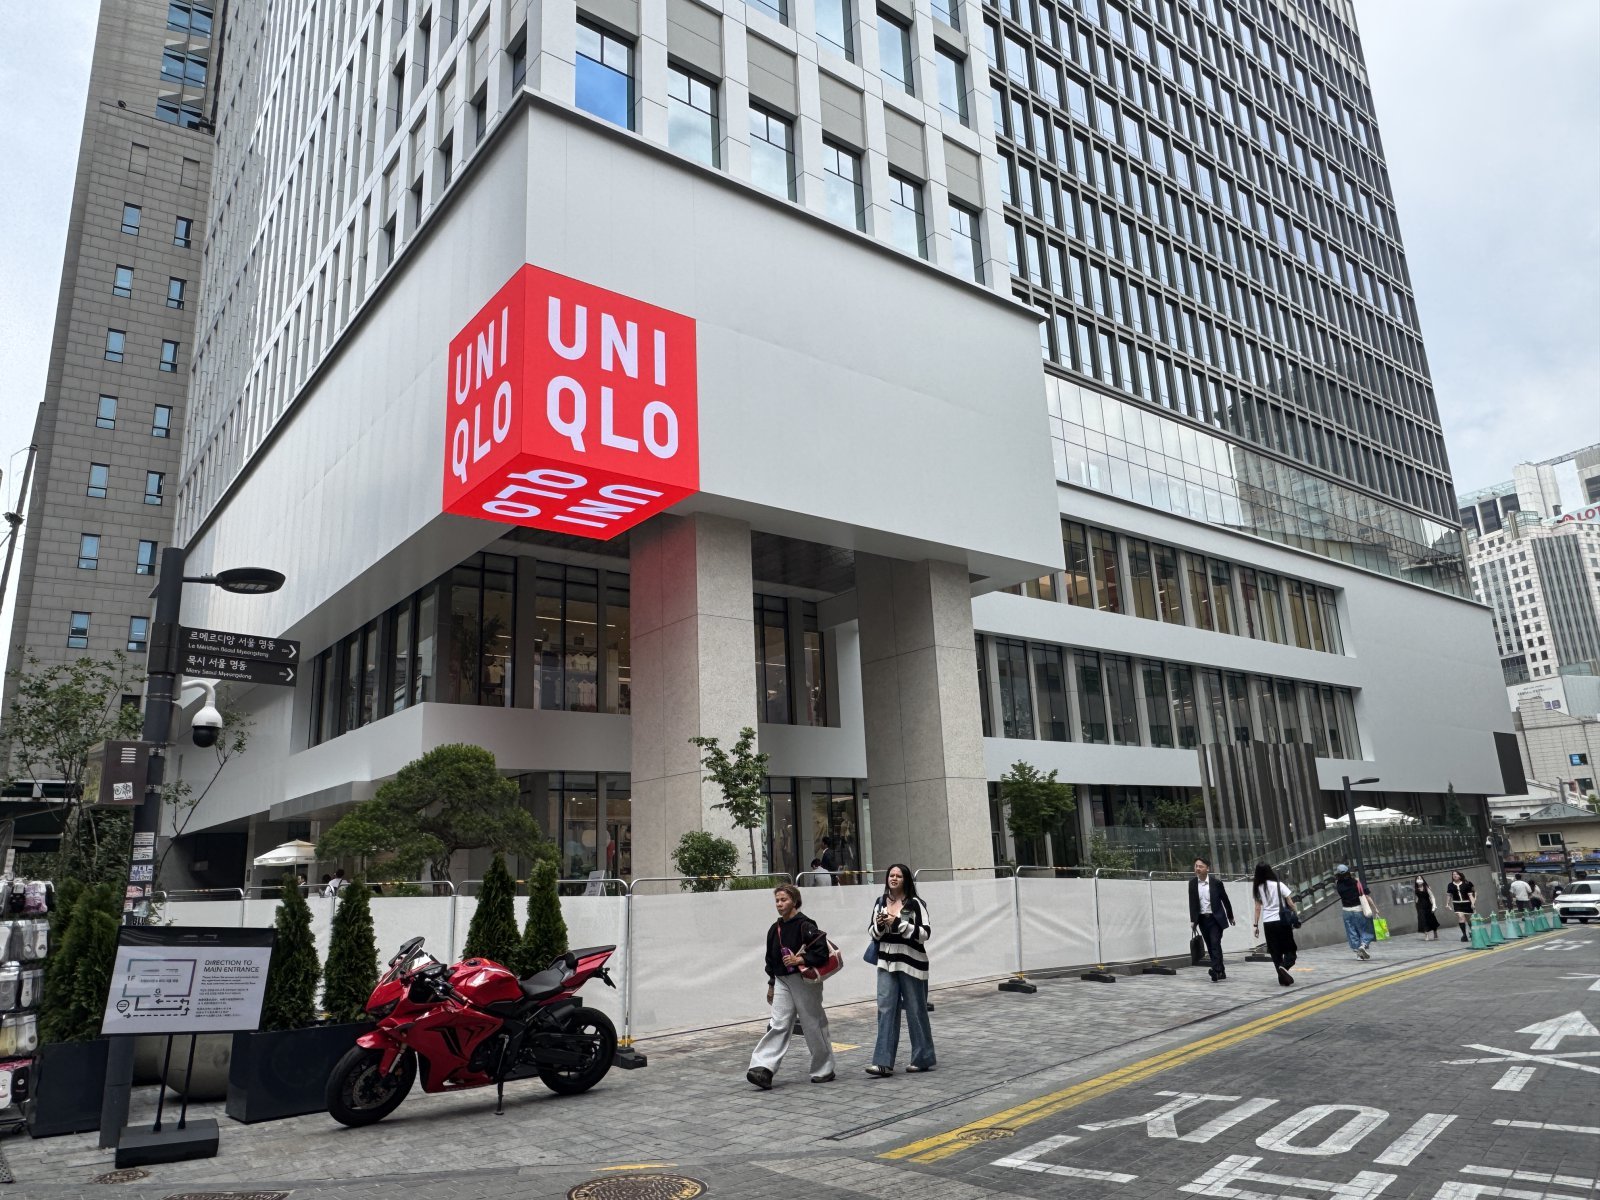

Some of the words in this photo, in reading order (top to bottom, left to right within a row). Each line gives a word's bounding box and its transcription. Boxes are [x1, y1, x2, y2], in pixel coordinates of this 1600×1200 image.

[455, 305, 509, 406] UNI
[547, 295, 666, 387] UNI
[452, 380, 512, 484] QLO
[546, 375, 679, 460] QLO
[482, 468, 588, 518] QLO
[553, 484, 665, 529] UNI
[187, 655, 206, 667] 목시
[208, 657, 227, 669] 서울
[229, 659, 248, 671] 명동
[189, 631, 235, 646] 르메르디앙
[238, 637, 255, 648] 서울
[258, 639, 275, 650] 명동
